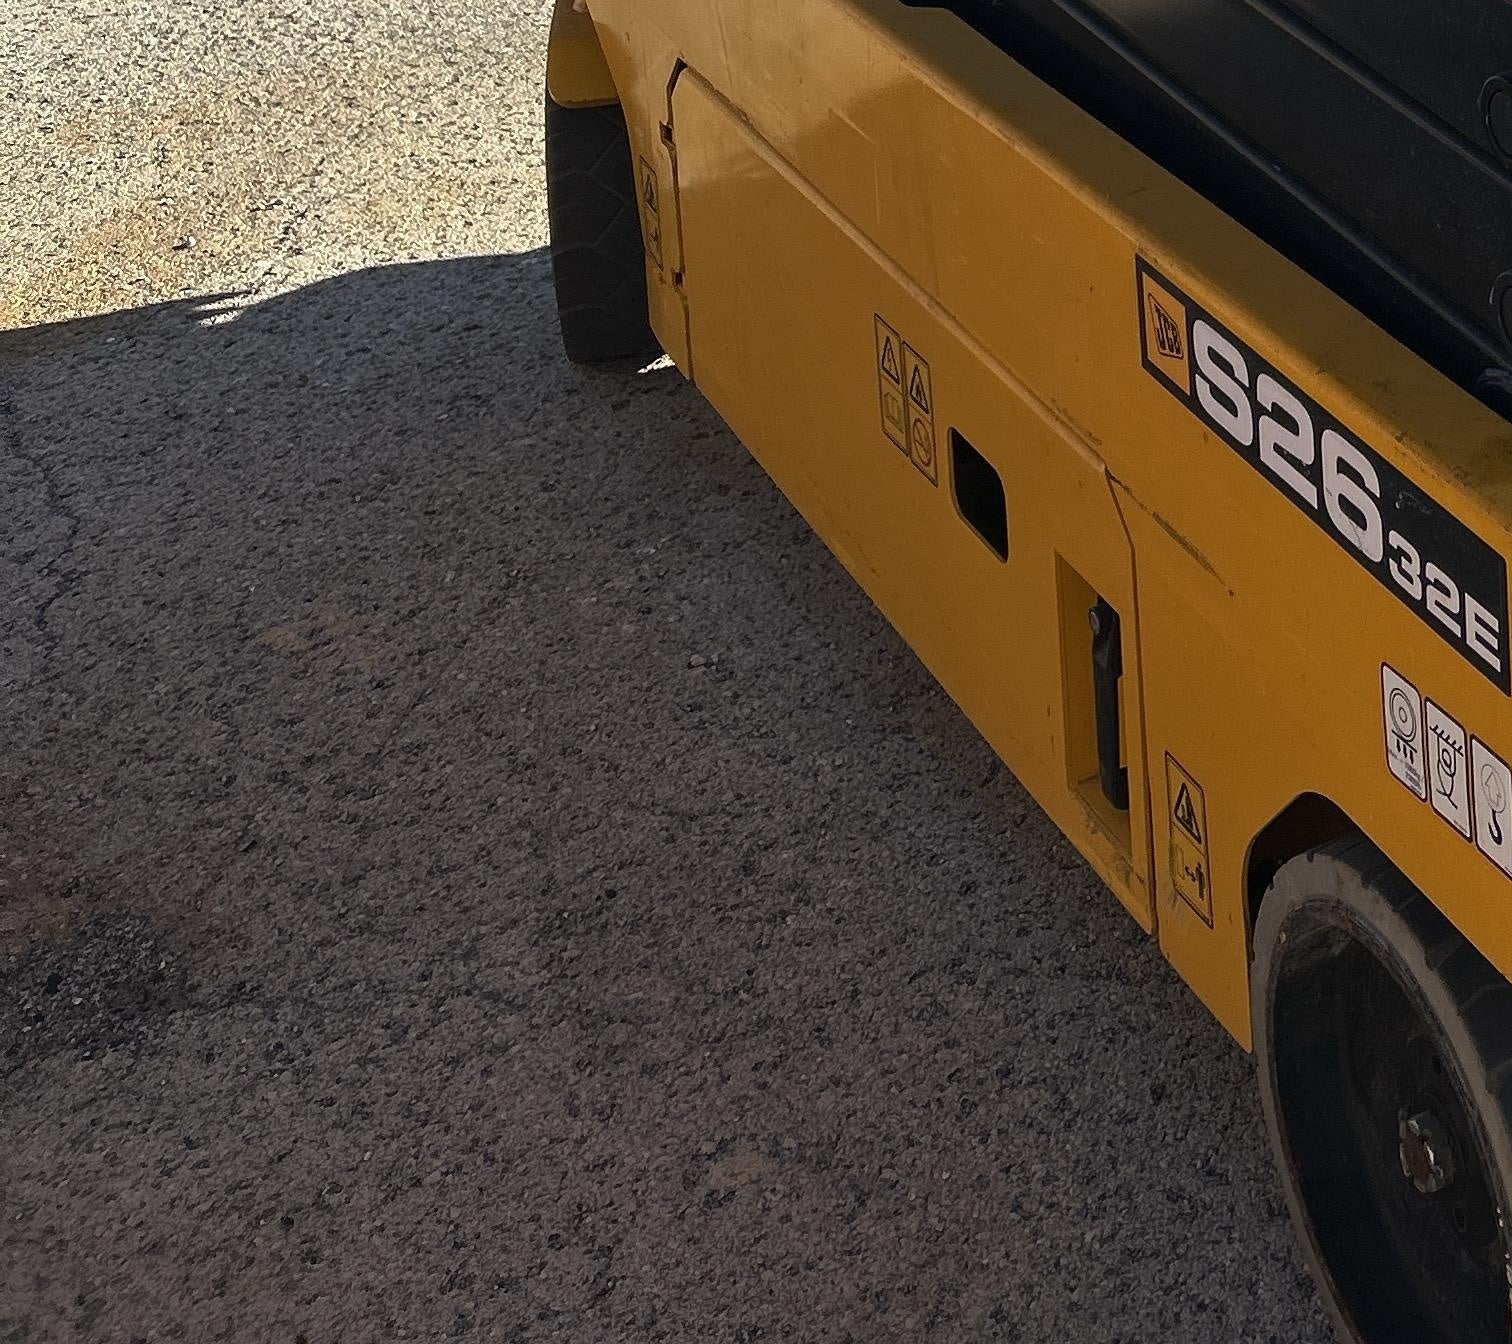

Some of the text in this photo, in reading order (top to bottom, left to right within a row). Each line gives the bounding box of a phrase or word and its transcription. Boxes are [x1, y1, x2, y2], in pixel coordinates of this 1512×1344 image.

[1153, 301, 1183, 356] JCB
[1192, 319, 1502, 673] S26 32E
